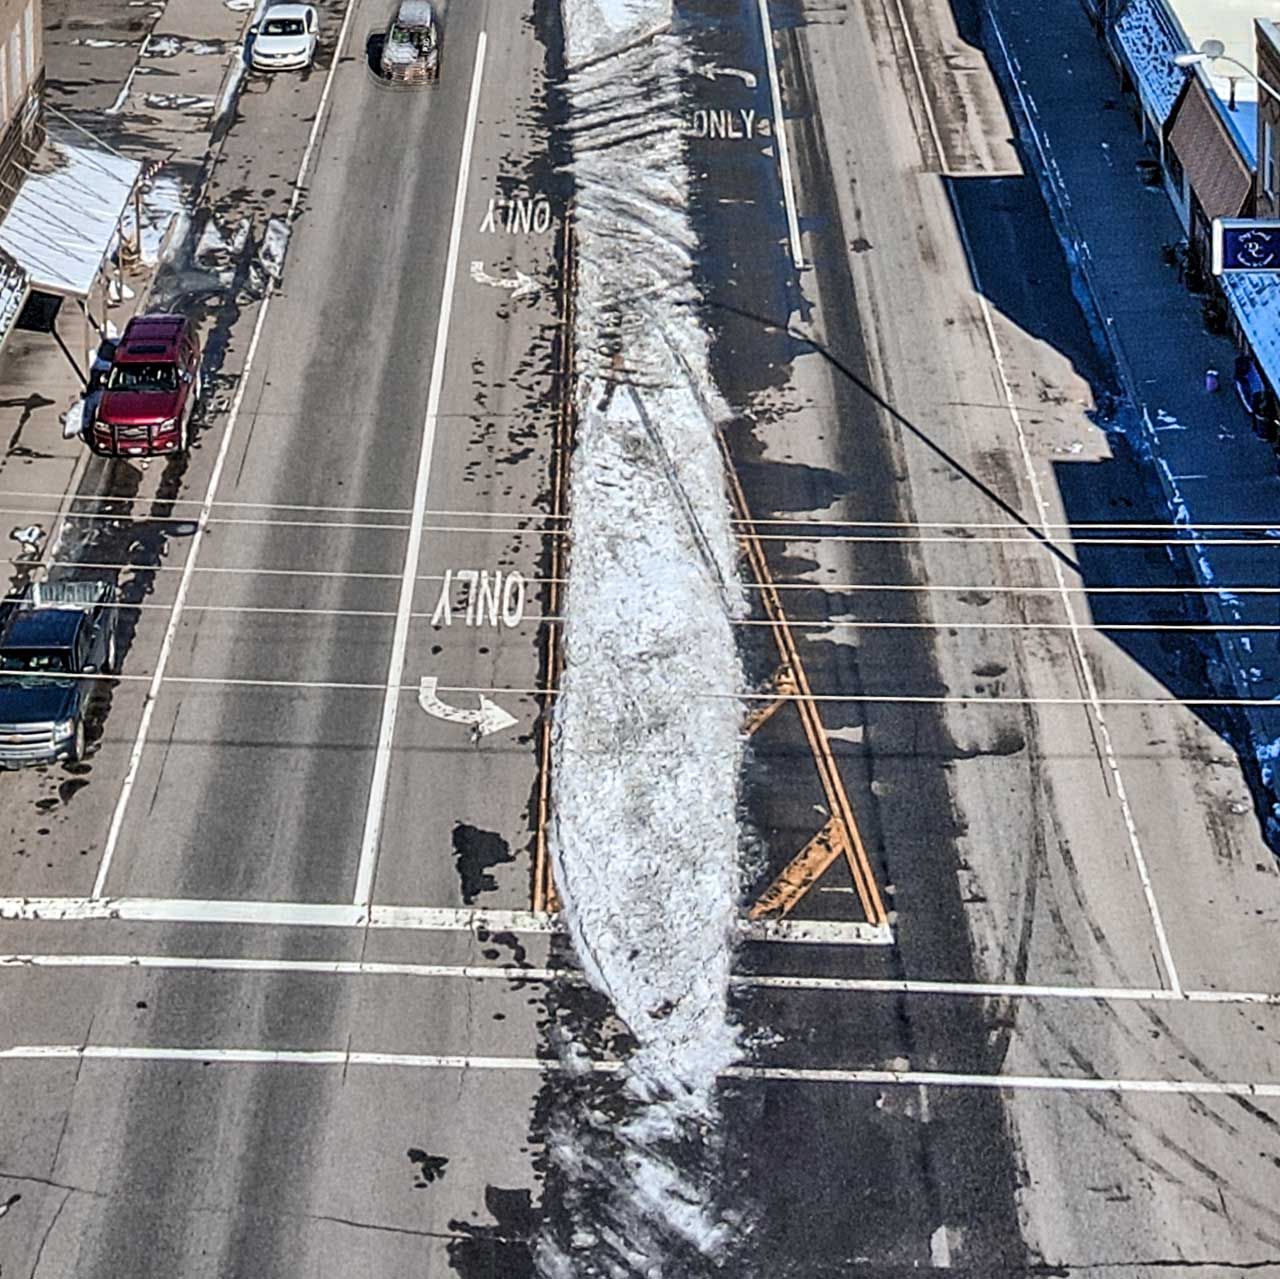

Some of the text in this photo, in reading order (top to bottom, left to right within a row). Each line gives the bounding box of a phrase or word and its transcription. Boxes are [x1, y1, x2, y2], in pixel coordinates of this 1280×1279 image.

[690, 108, 756, 140] ONLY
[479, 197, 552, 235] ONLY
[431, 569, 527, 628] ONLY
